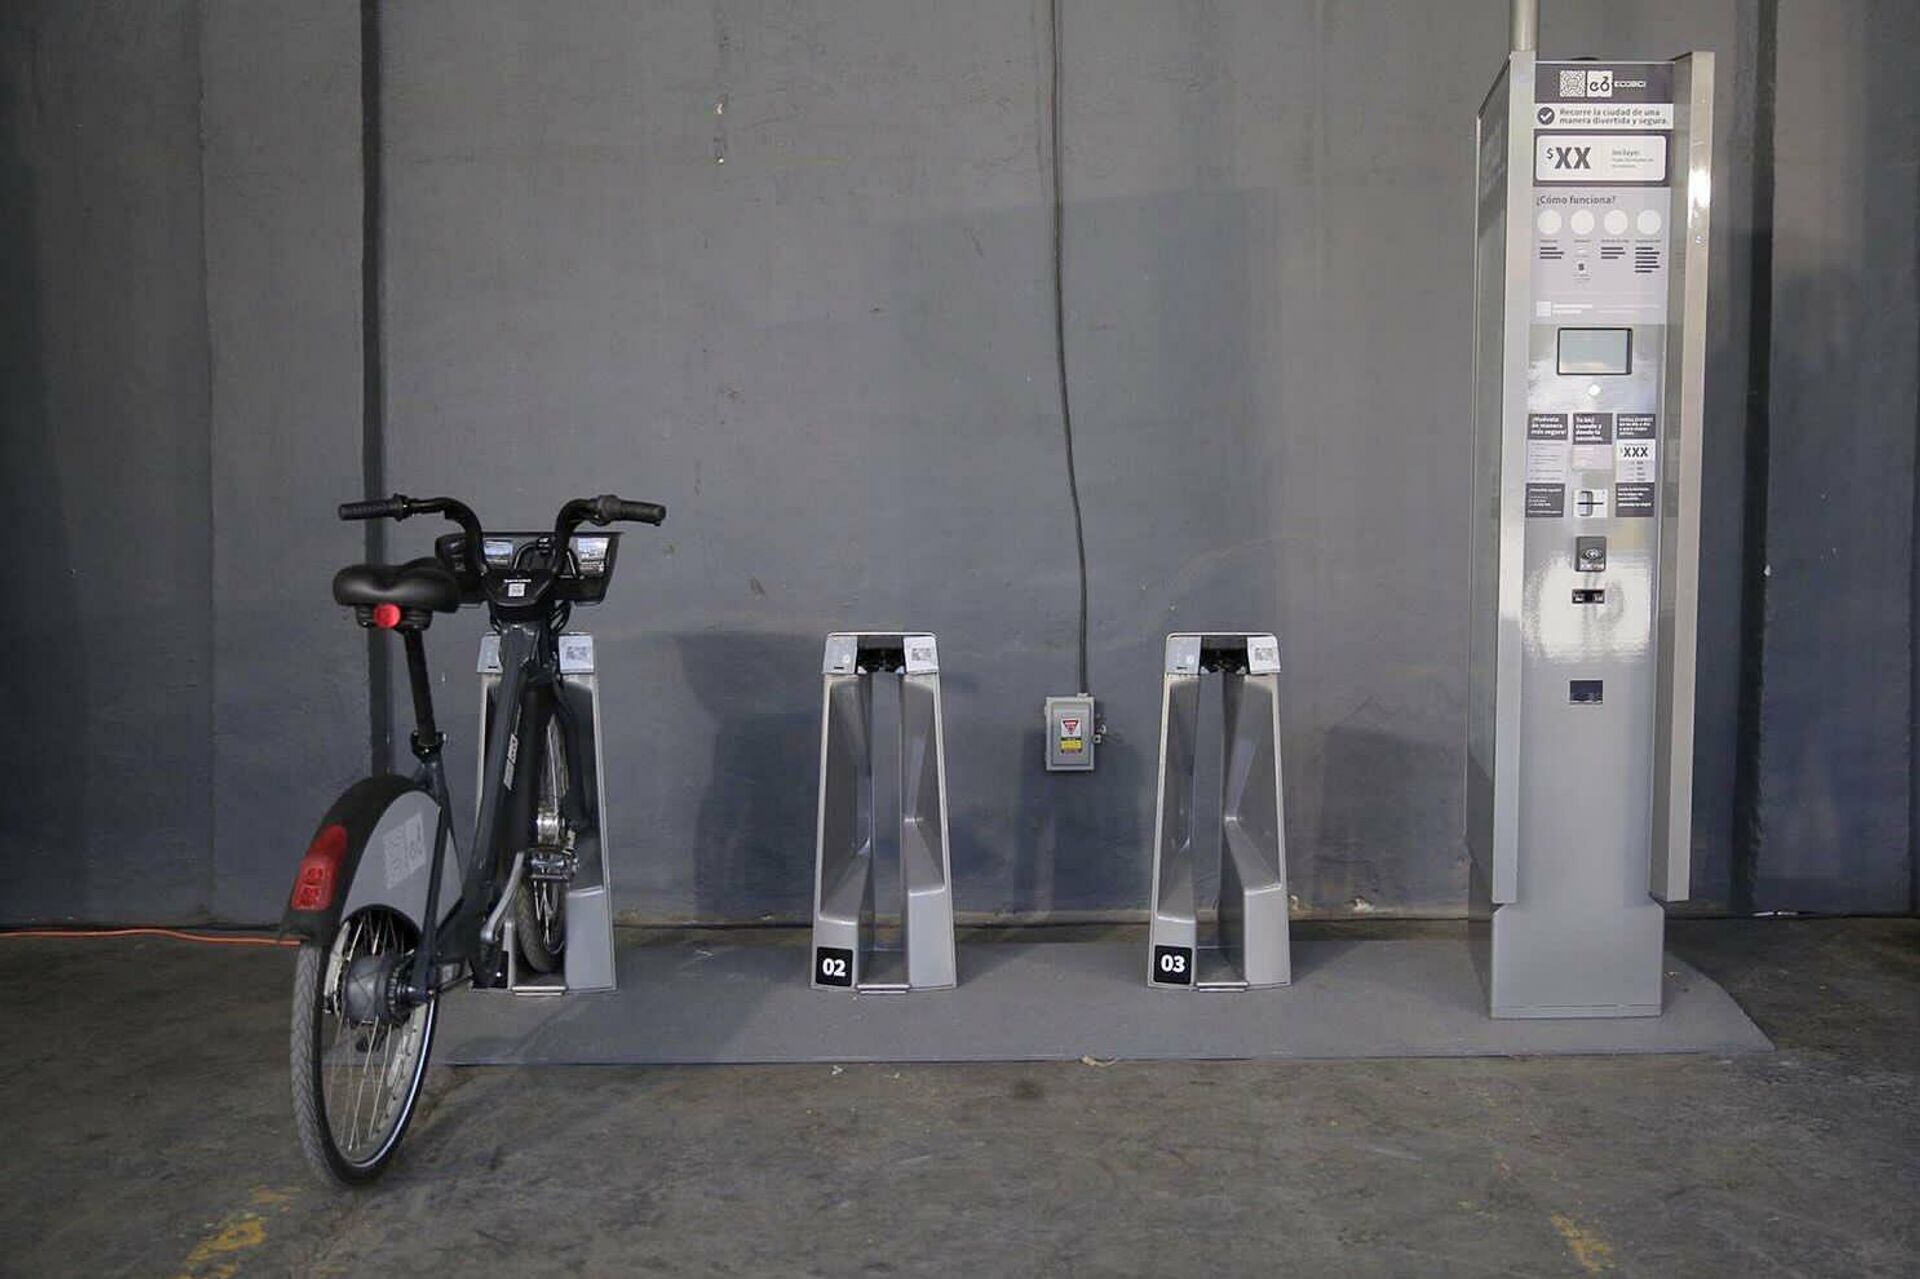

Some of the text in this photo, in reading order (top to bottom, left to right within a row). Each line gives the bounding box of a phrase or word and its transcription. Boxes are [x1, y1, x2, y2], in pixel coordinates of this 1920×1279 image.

[1560, 108, 1592, 116] Recorre
[1593, 108, 1601, 116] la
[1602, 108, 1631, 116] ciudad
[1632, 108, 1643, 116] de
[1593, 115, 1630, 124] divertida
[1536, 194, 1616, 206] ¿Cómo funciona?
[822, 958, 846, 977] 02
[1160, 954, 1185, 973] 03
